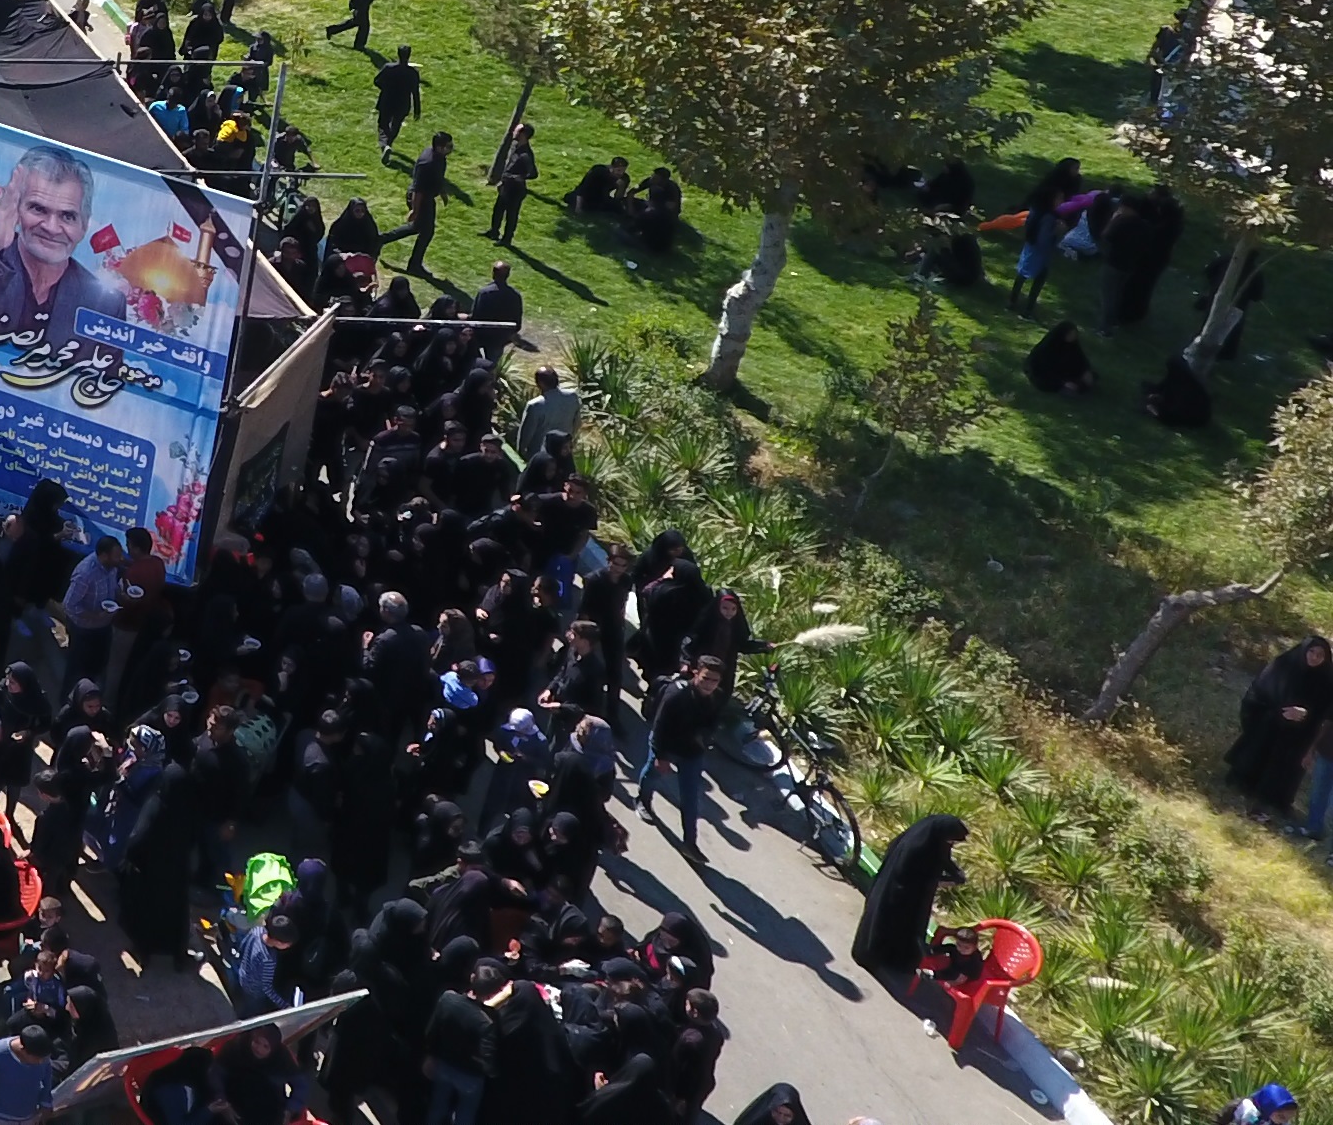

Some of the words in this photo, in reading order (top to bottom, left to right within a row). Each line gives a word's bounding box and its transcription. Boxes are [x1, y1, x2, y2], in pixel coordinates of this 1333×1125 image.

[83, 319, 135, 344] اندیش
[140, 338, 167, 356] خیر
[171, 347, 211, 374] واقف
[117, 365, 162, 388] مرحوم
[73, 368, 123, 406] حاج
[18, 412, 45, 430] غیر
[16, 435, 48, 453] جهت
[47, 421, 103, 449] دبستان
[26, 453, 70, 472] آموزان
[49, 446, 91, 466] دبستان
[107, 440, 148, 469] واقف
[71, 468, 98, 483] دانش
[91, 462, 109, 474] این
[64, 480, 113, 503] سرپرست
[99, 477, 141, 497] تحصیل
[74, 497, 100, 512] صرف
[115, 501, 139, 514] بی
[101, 508, 136, 527] پرورش
